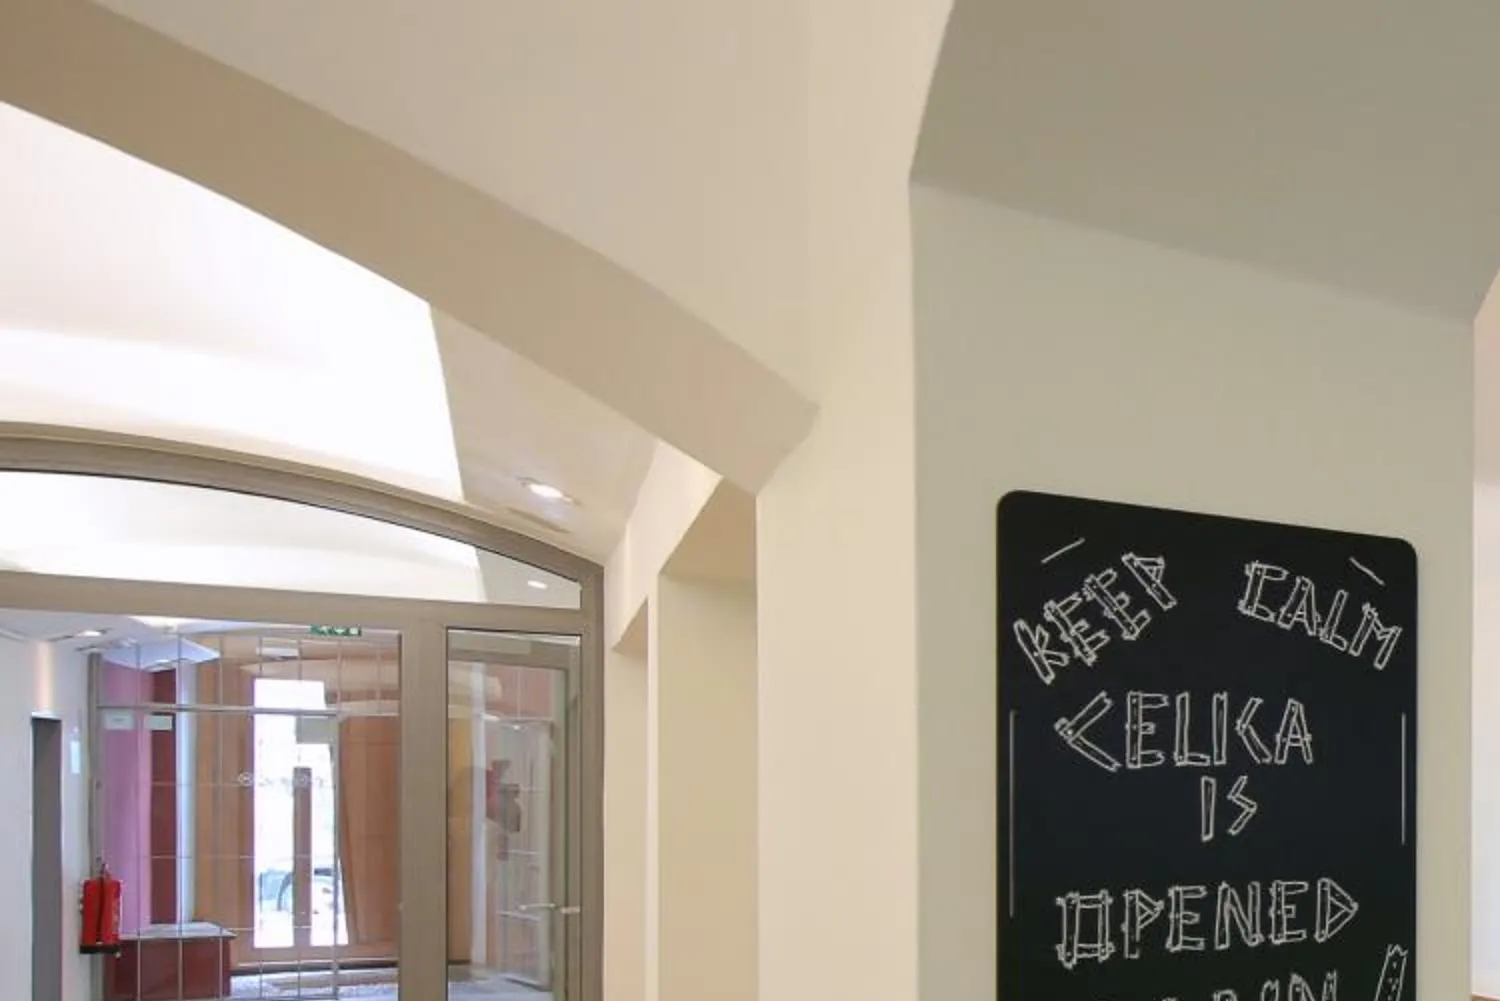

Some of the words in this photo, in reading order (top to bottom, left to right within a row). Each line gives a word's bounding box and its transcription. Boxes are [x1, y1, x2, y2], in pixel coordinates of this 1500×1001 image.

[1013, 552, 1177, 685] KEEP
[1237, 559, 1402, 670] CALM
[1054, 691, 1313, 772] CELICA
[1201, 776, 1257, 842] IS
[1056, 878, 1358, 969] OPENED
